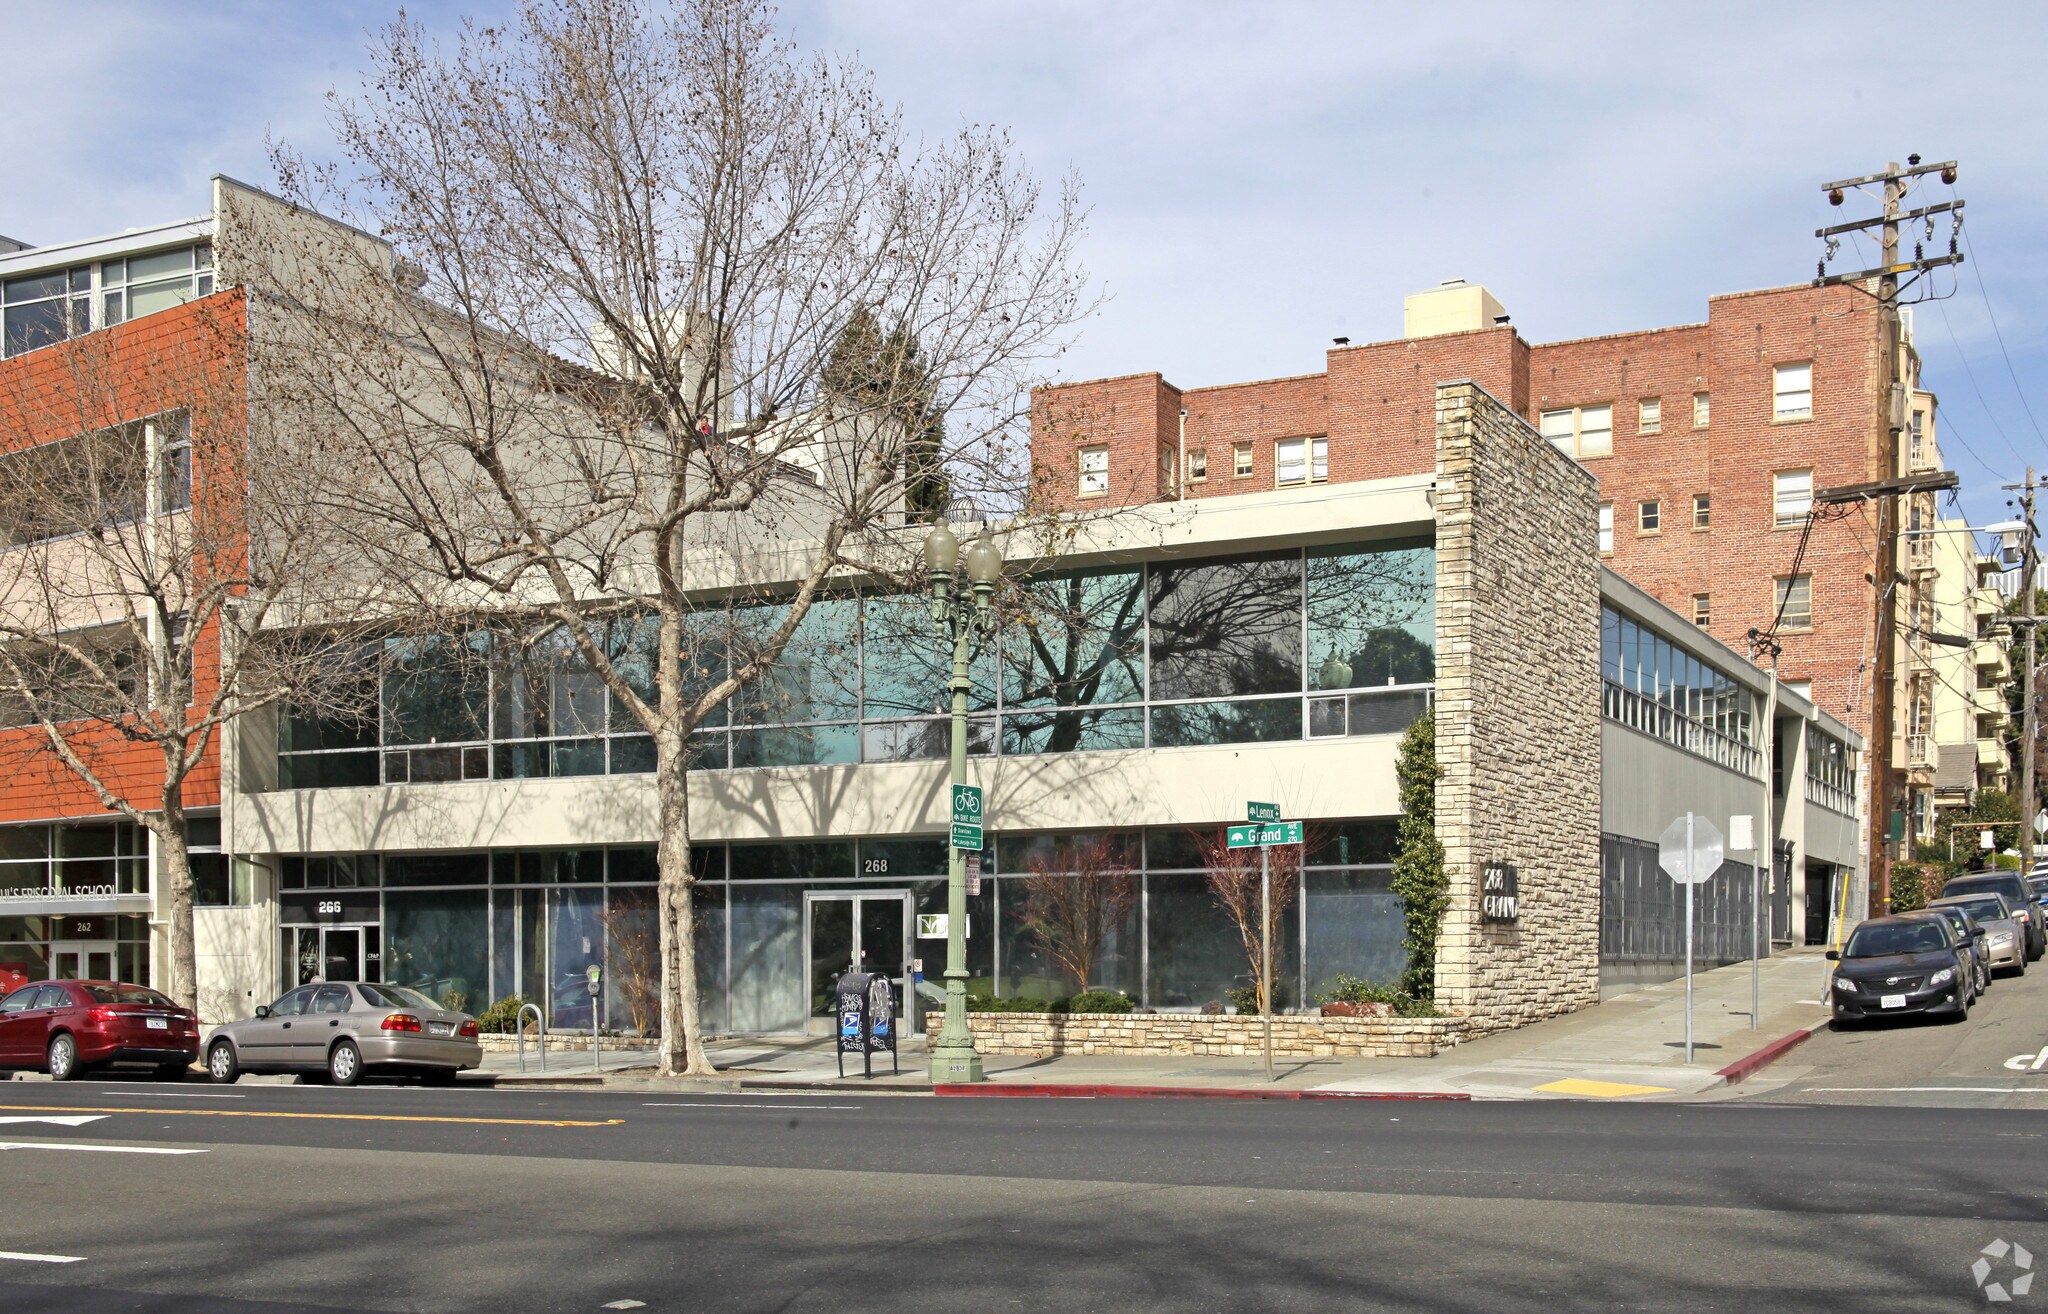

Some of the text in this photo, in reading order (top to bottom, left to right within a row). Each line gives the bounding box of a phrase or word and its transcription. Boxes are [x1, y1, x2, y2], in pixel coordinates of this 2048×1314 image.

[960, 814, 969, 822] BIKE
[1256, 805, 1274, 819] Lenox
[1248, 827, 1281, 843] Grand
[865, 859, 888, 873] 268
[1484, 868, 1504, 890] 268
[75, 884, 117, 899] SCHOOL
[318, 901, 341, 913] 266
[1483, 895, 1518, 918] GRAND
[77, 922, 91, 932] 262
